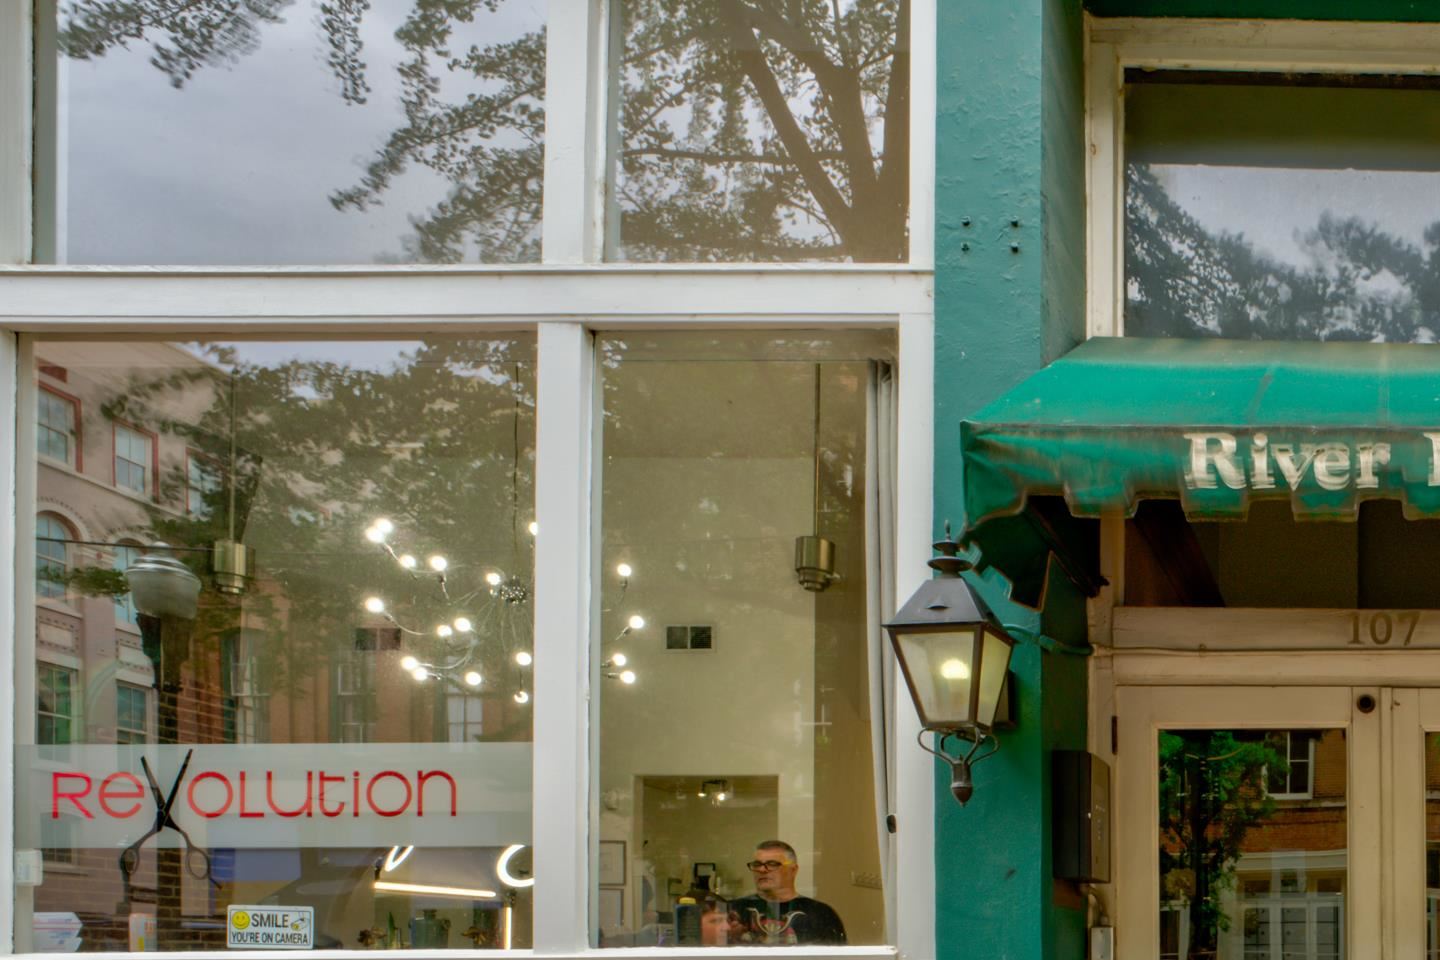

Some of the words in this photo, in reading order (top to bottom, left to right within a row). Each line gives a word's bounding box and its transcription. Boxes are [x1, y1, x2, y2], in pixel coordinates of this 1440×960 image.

[1183, 431, 1391, 491] River
[1347, 611, 1421, 646] 107
[251, 913, 289, 928] SMILE
[232, 931, 260, 943] YOU'RE
[262, 932, 273, 943] ON
[275, 932, 308, 944] CAMERA
